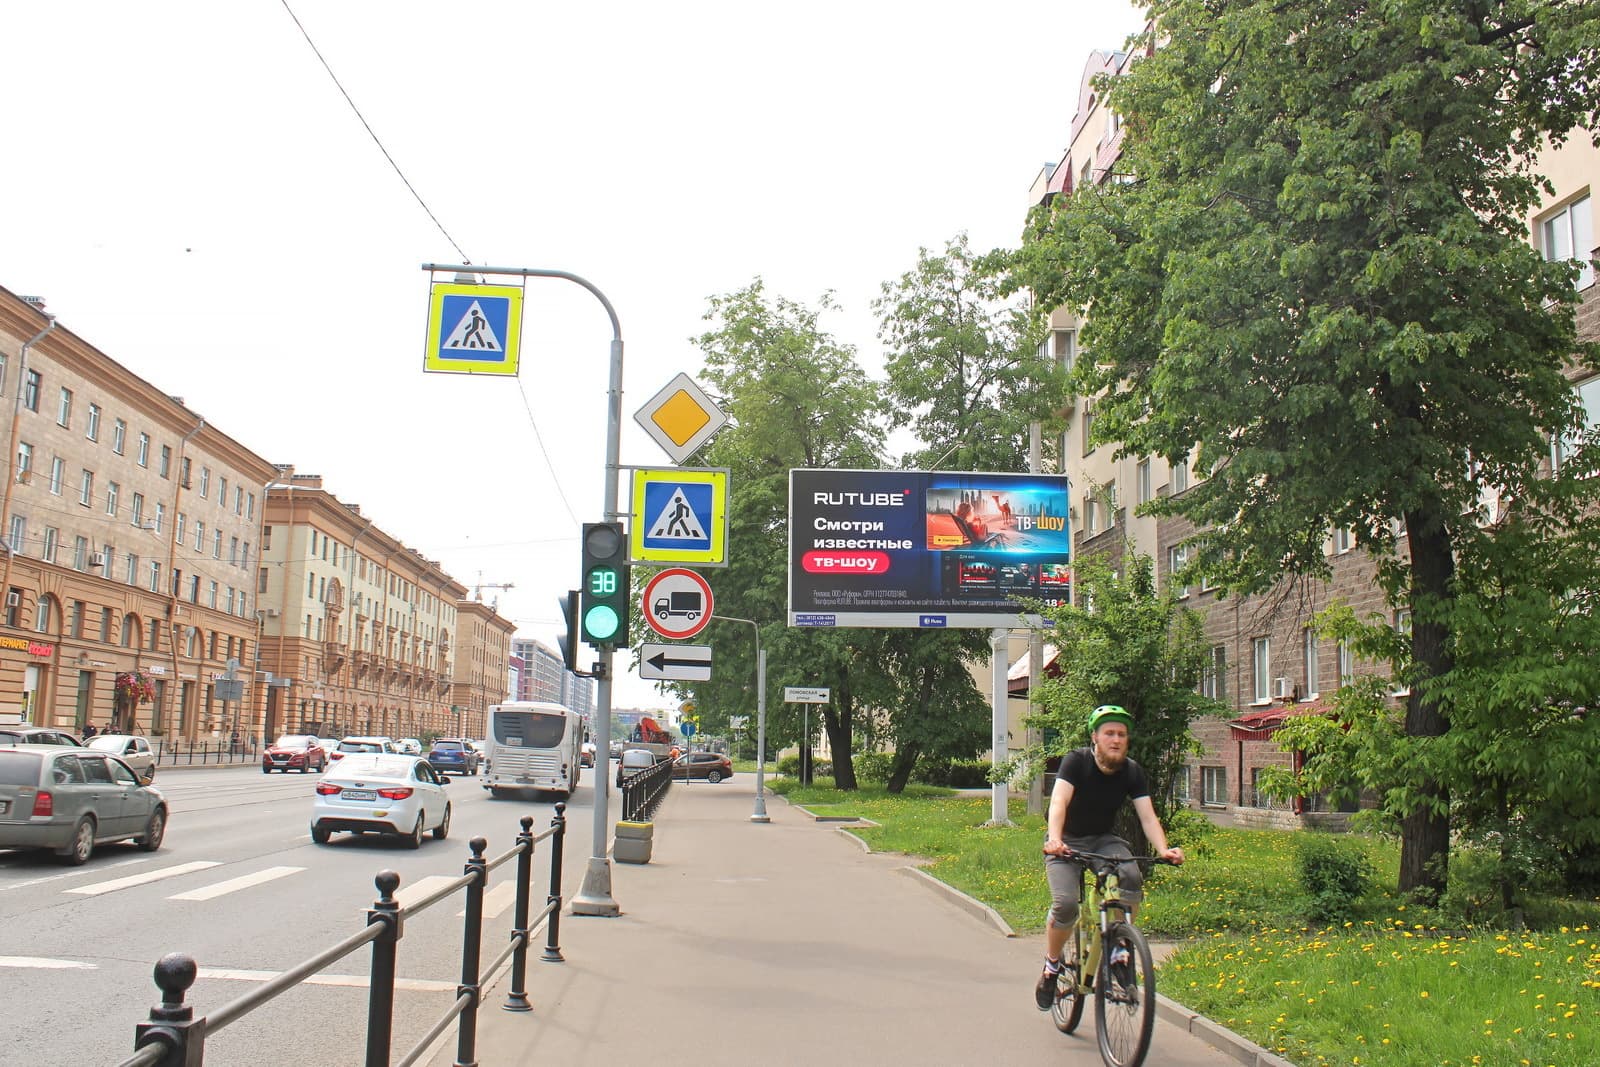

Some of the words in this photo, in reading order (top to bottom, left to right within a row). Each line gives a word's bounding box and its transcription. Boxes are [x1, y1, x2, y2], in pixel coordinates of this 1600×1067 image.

[814, 492, 904, 506] RUTUBE
[814, 517, 884, 534] Смотри
[814, 538, 913, 549] известные
[813, 557, 878, 571] тв-шоу
[592, 572, 616, 593] 38
